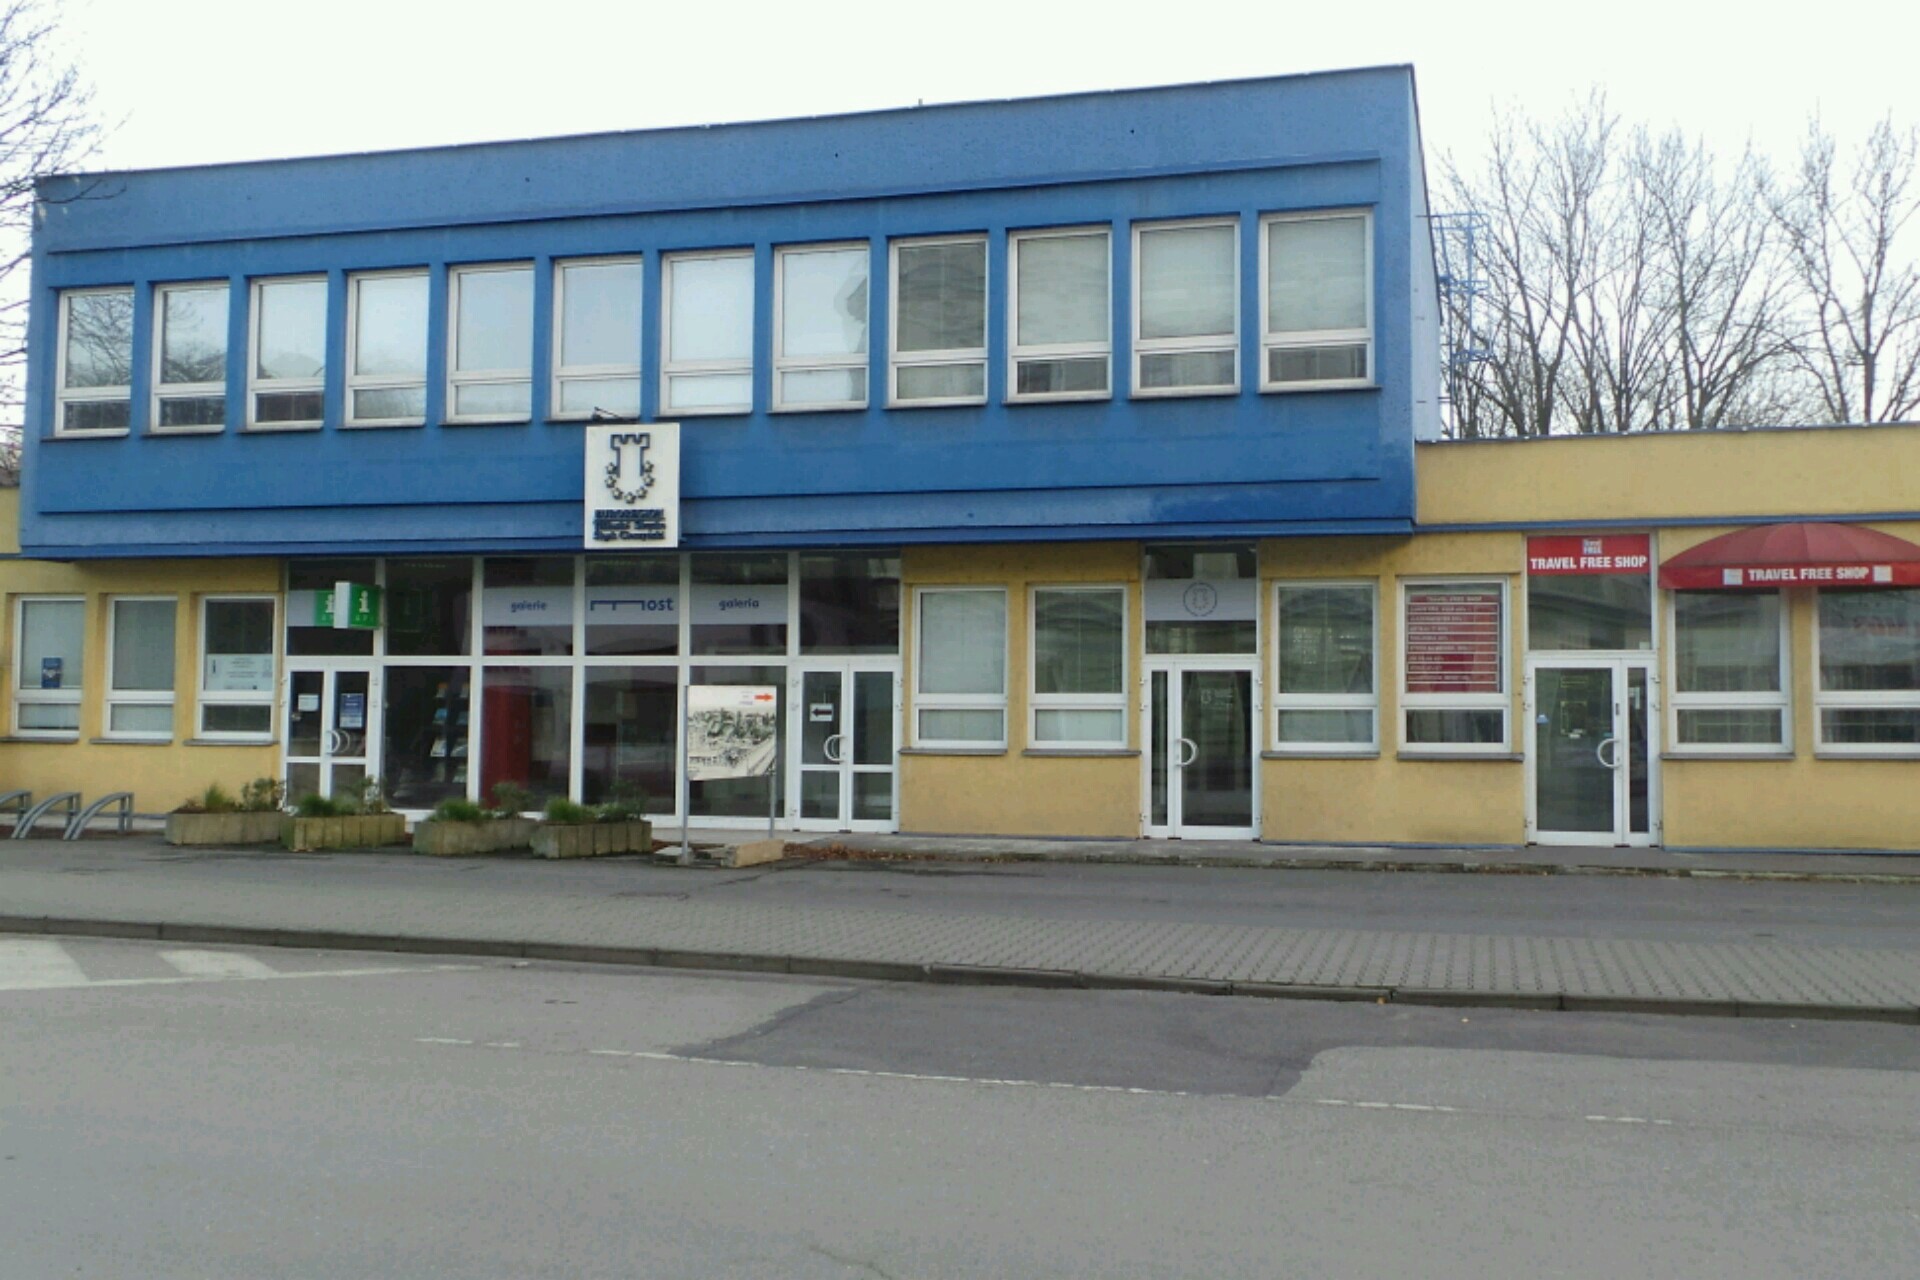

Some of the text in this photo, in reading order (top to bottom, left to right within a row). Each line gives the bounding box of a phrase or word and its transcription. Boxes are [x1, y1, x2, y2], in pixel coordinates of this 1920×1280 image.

[1530, 555, 1648, 570] TRAVEL FREE SHOP
[1748, 568, 1797, 581] TRAVEL
[1800, 567, 1832, 580] FREE
[1836, 566, 1869, 579] SHOP
[510, 599, 547, 613] galerie
[718, 598, 760, 611] galeria
